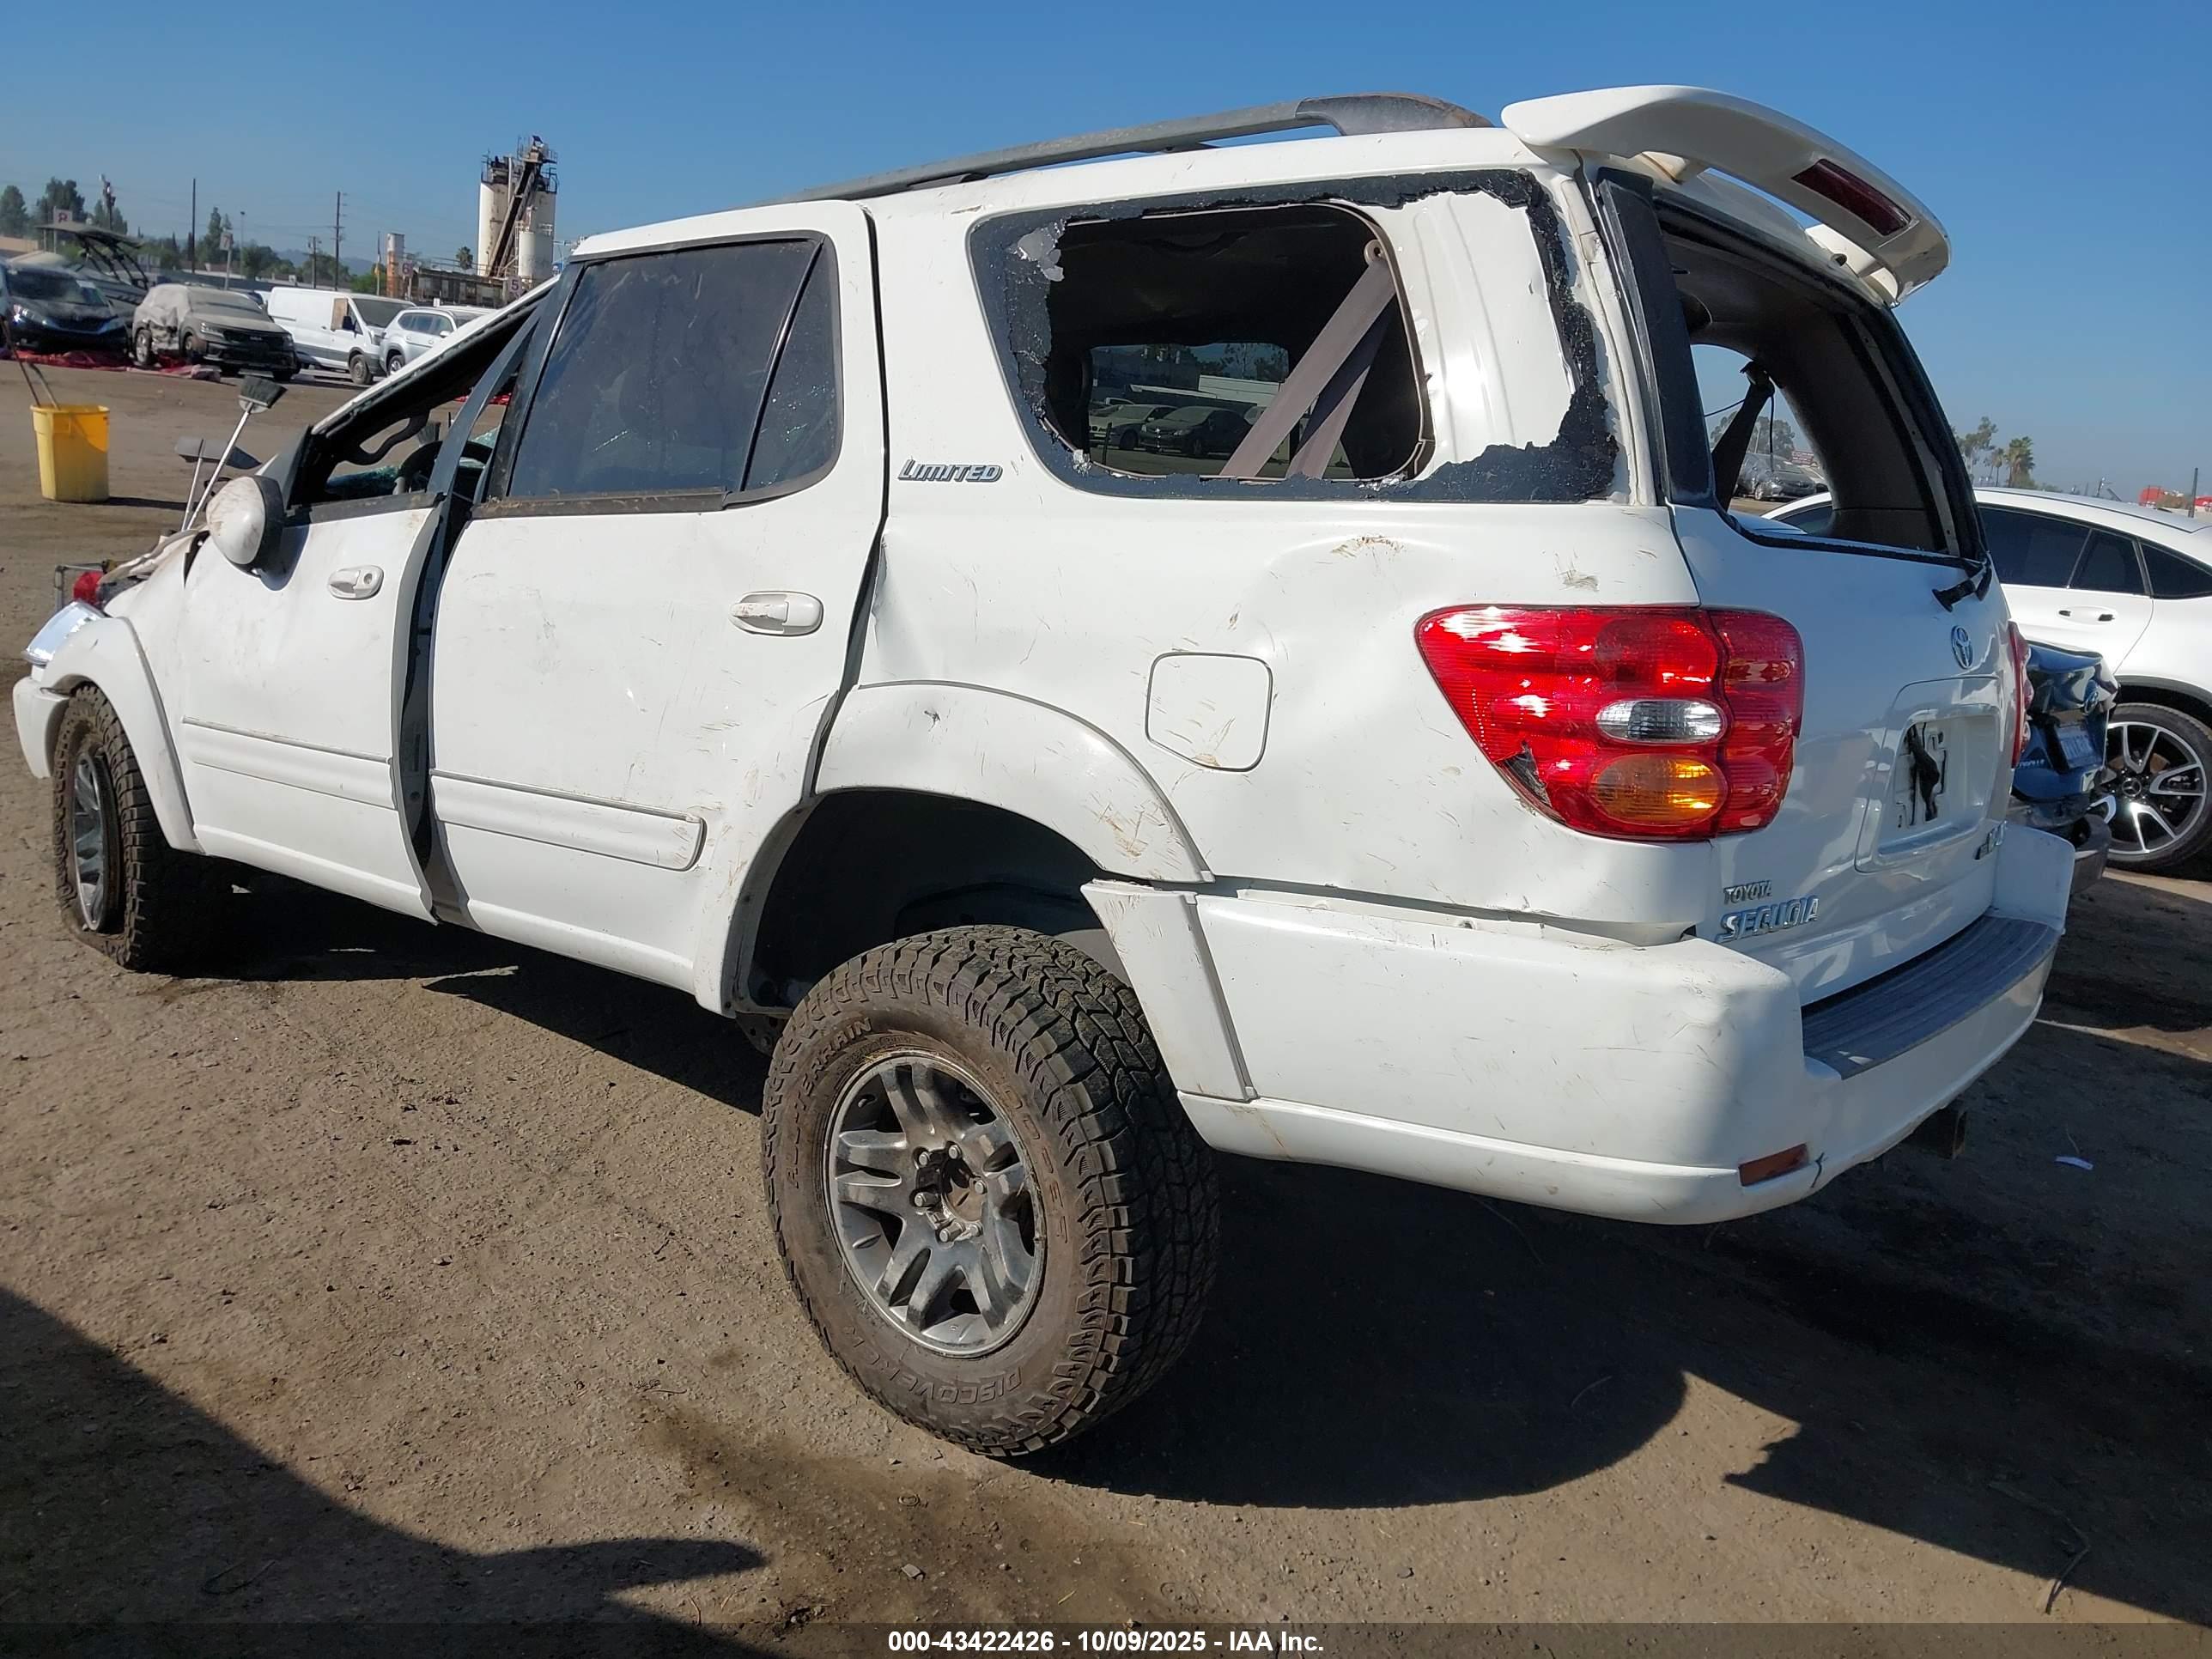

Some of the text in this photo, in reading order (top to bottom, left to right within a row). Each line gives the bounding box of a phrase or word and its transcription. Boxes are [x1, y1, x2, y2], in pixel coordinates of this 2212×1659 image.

[511, 279, 520, 291] 5
[897, 459, 1003, 483] LIMITED
[1714, 893, 1820, 944] SEQUOIA
